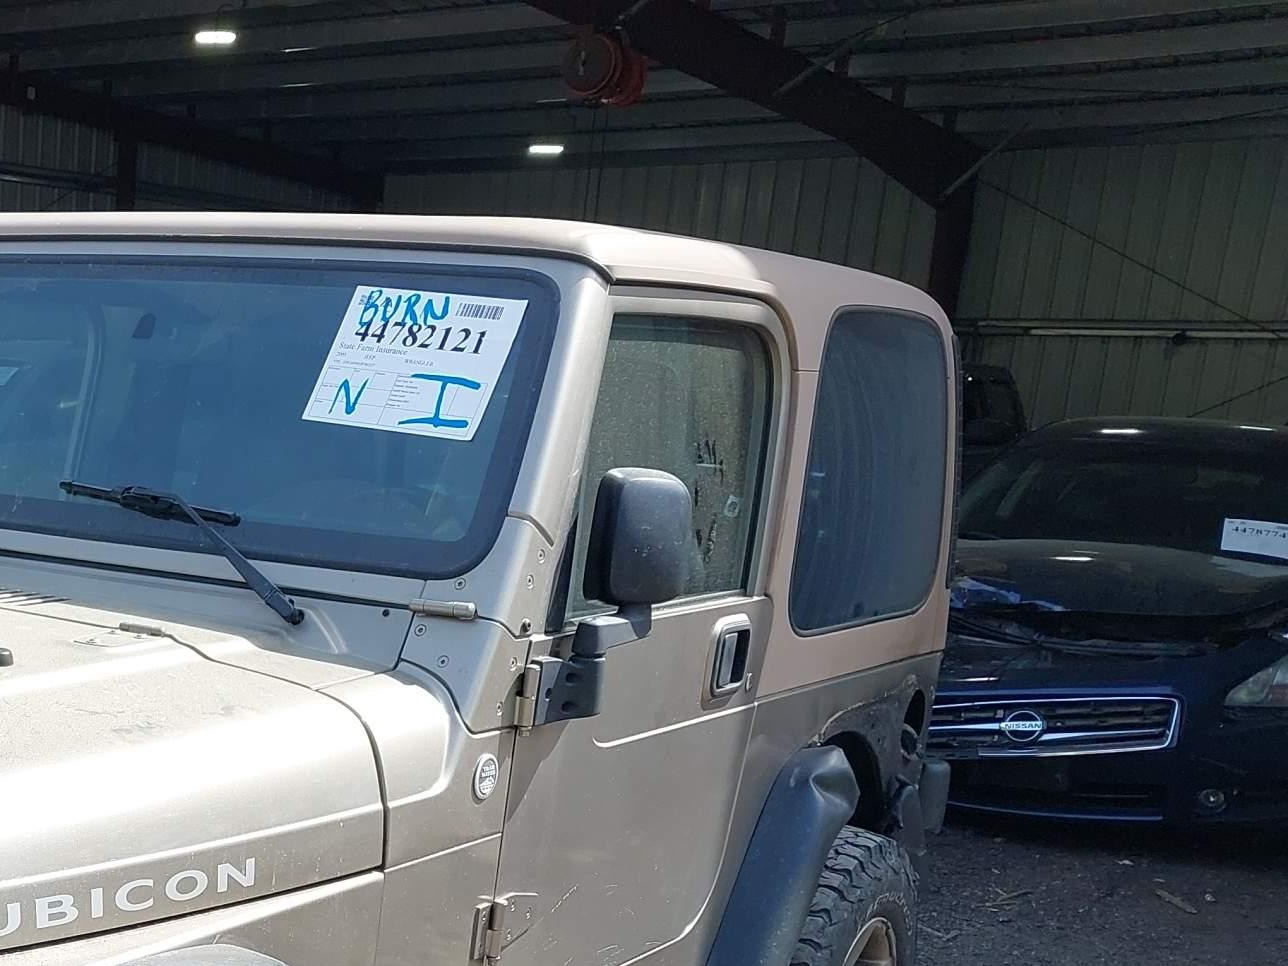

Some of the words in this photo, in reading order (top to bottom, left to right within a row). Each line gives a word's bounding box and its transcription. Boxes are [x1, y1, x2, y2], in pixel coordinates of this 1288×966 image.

[359, 289, 450, 327] BURN
[339, 342, 355, 350] State
[357, 343, 374, 352] Farm
[376, 345, 408, 356] Insurance
[355, 321, 488, 354] 44782121
[329, 378, 369, 415] N
